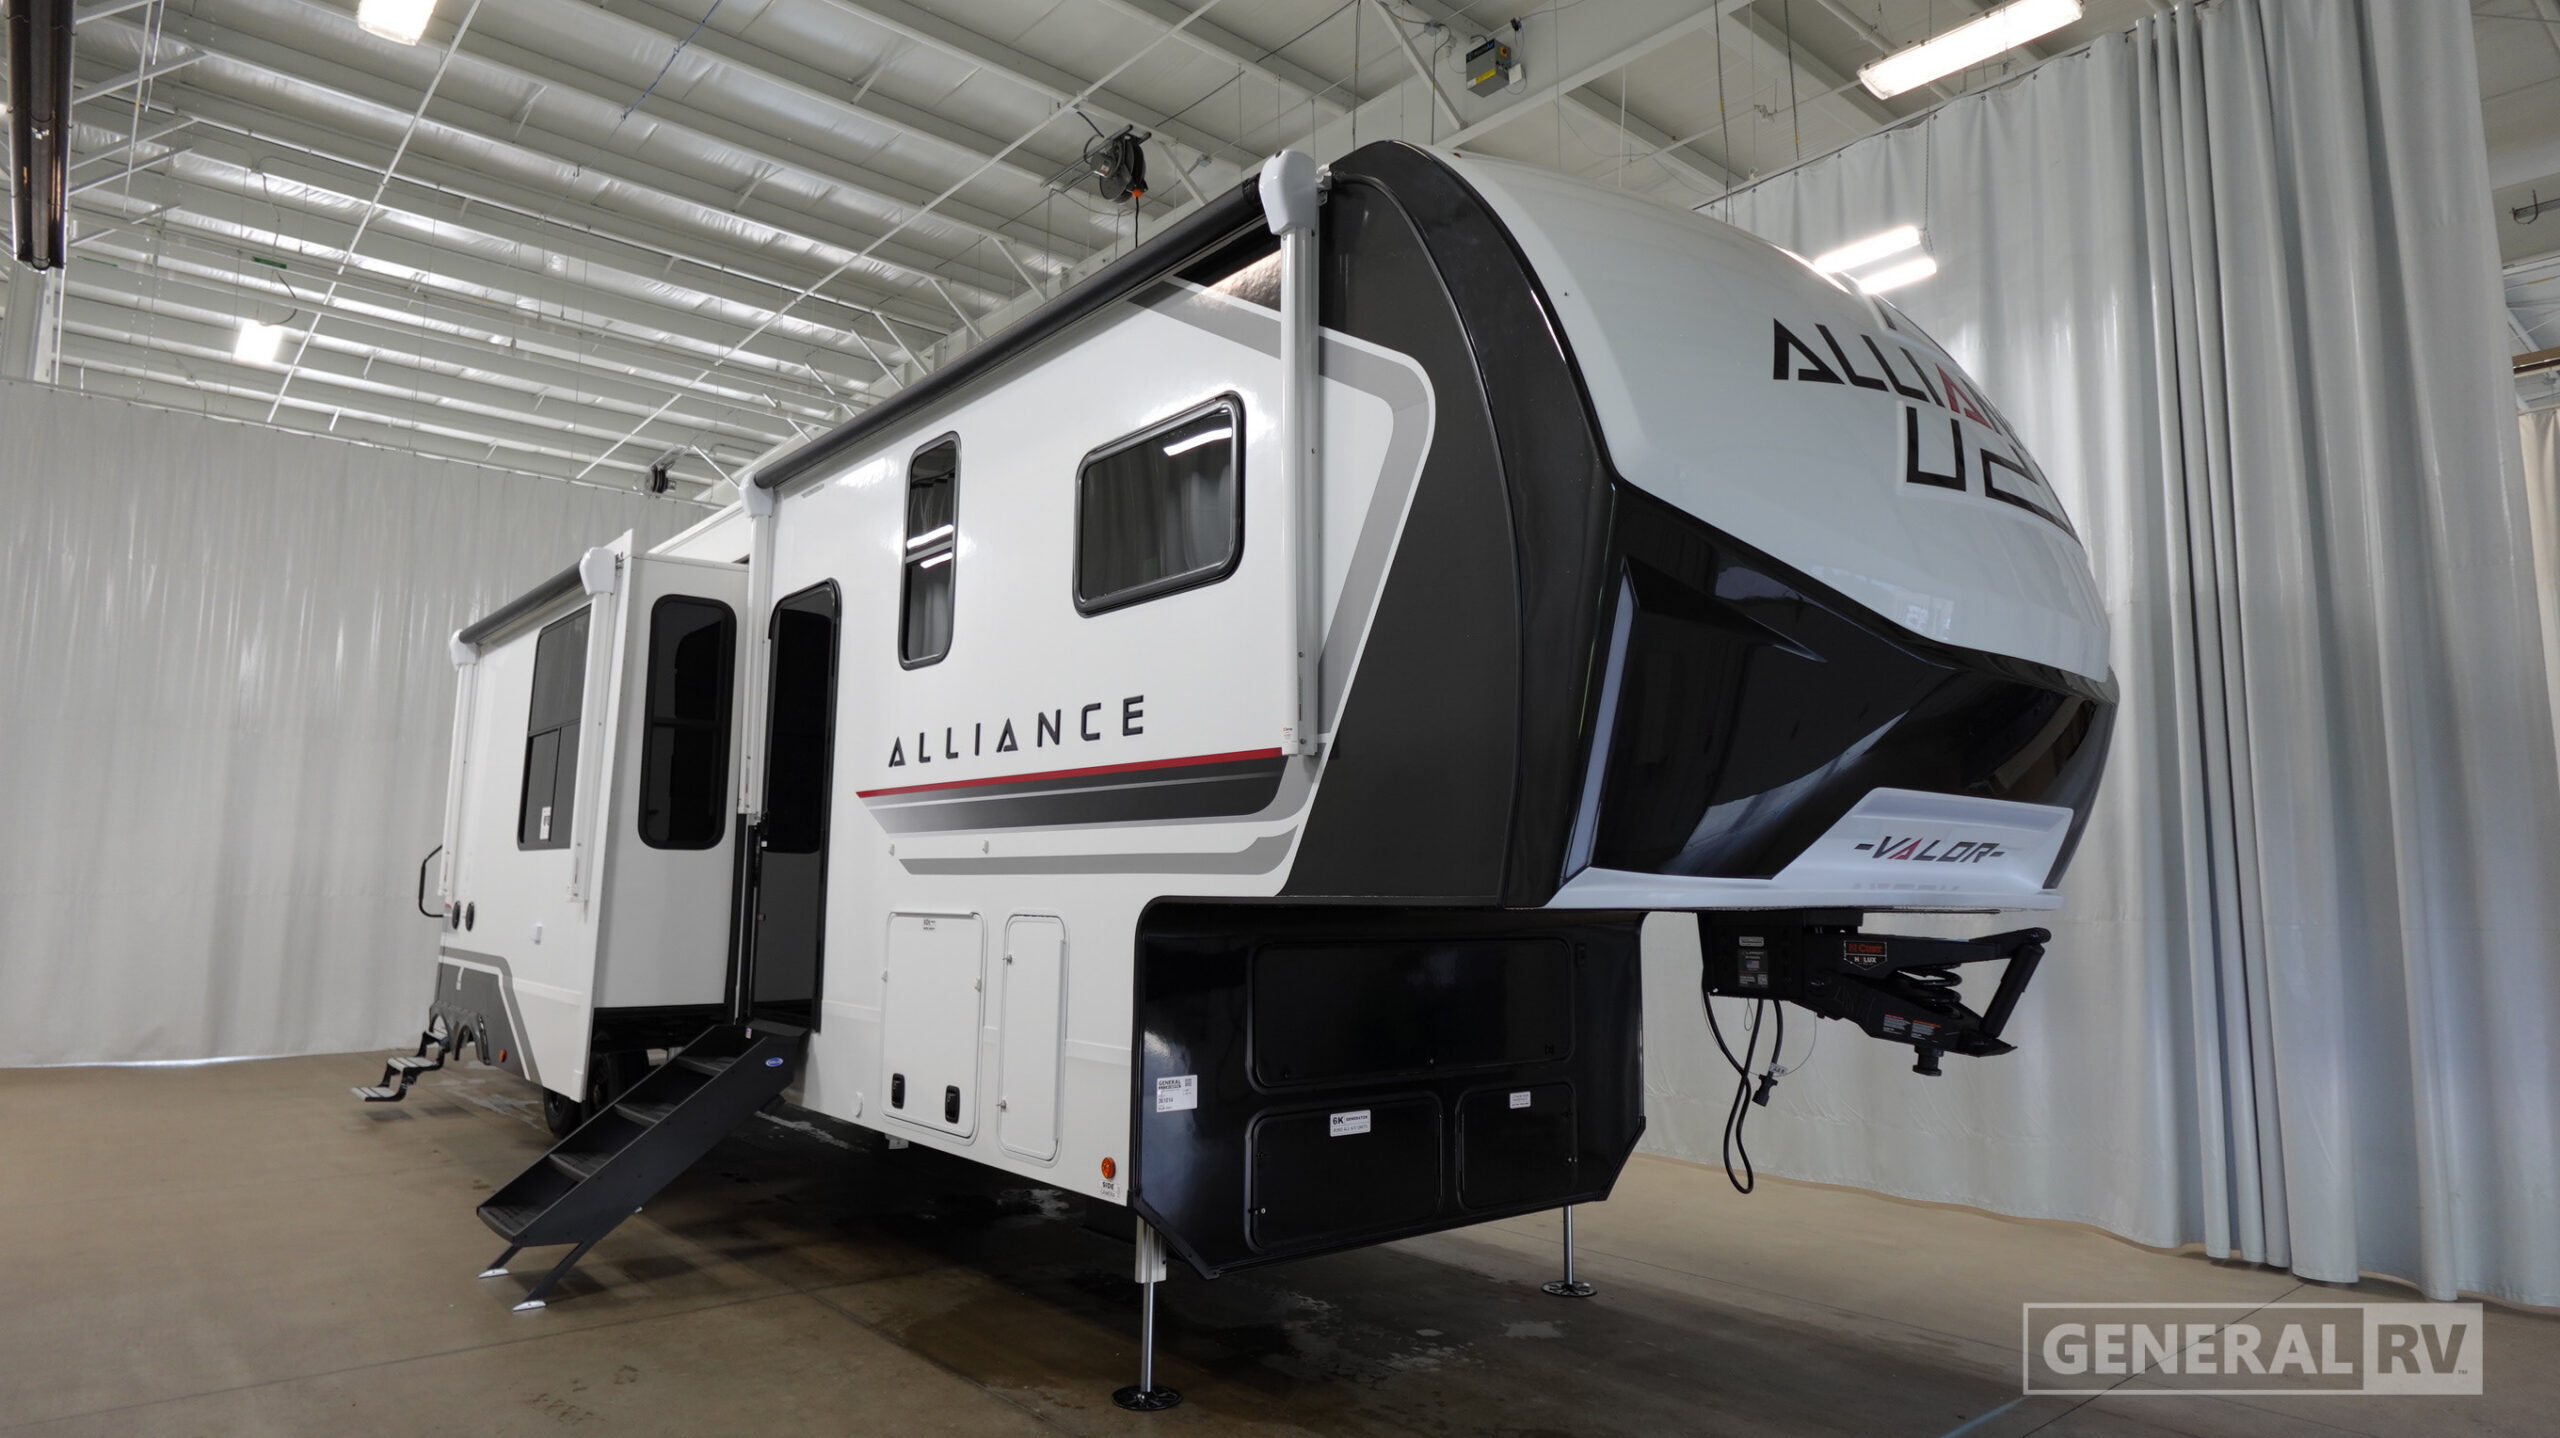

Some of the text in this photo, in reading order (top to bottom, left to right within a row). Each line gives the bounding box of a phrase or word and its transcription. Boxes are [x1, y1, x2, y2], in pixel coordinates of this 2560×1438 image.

[1773, 318, 2029, 456] ALLIAN
[888, 694, 1144, 768] ALLIANCE
[1333, 1116, 1344, 1125] 6K
